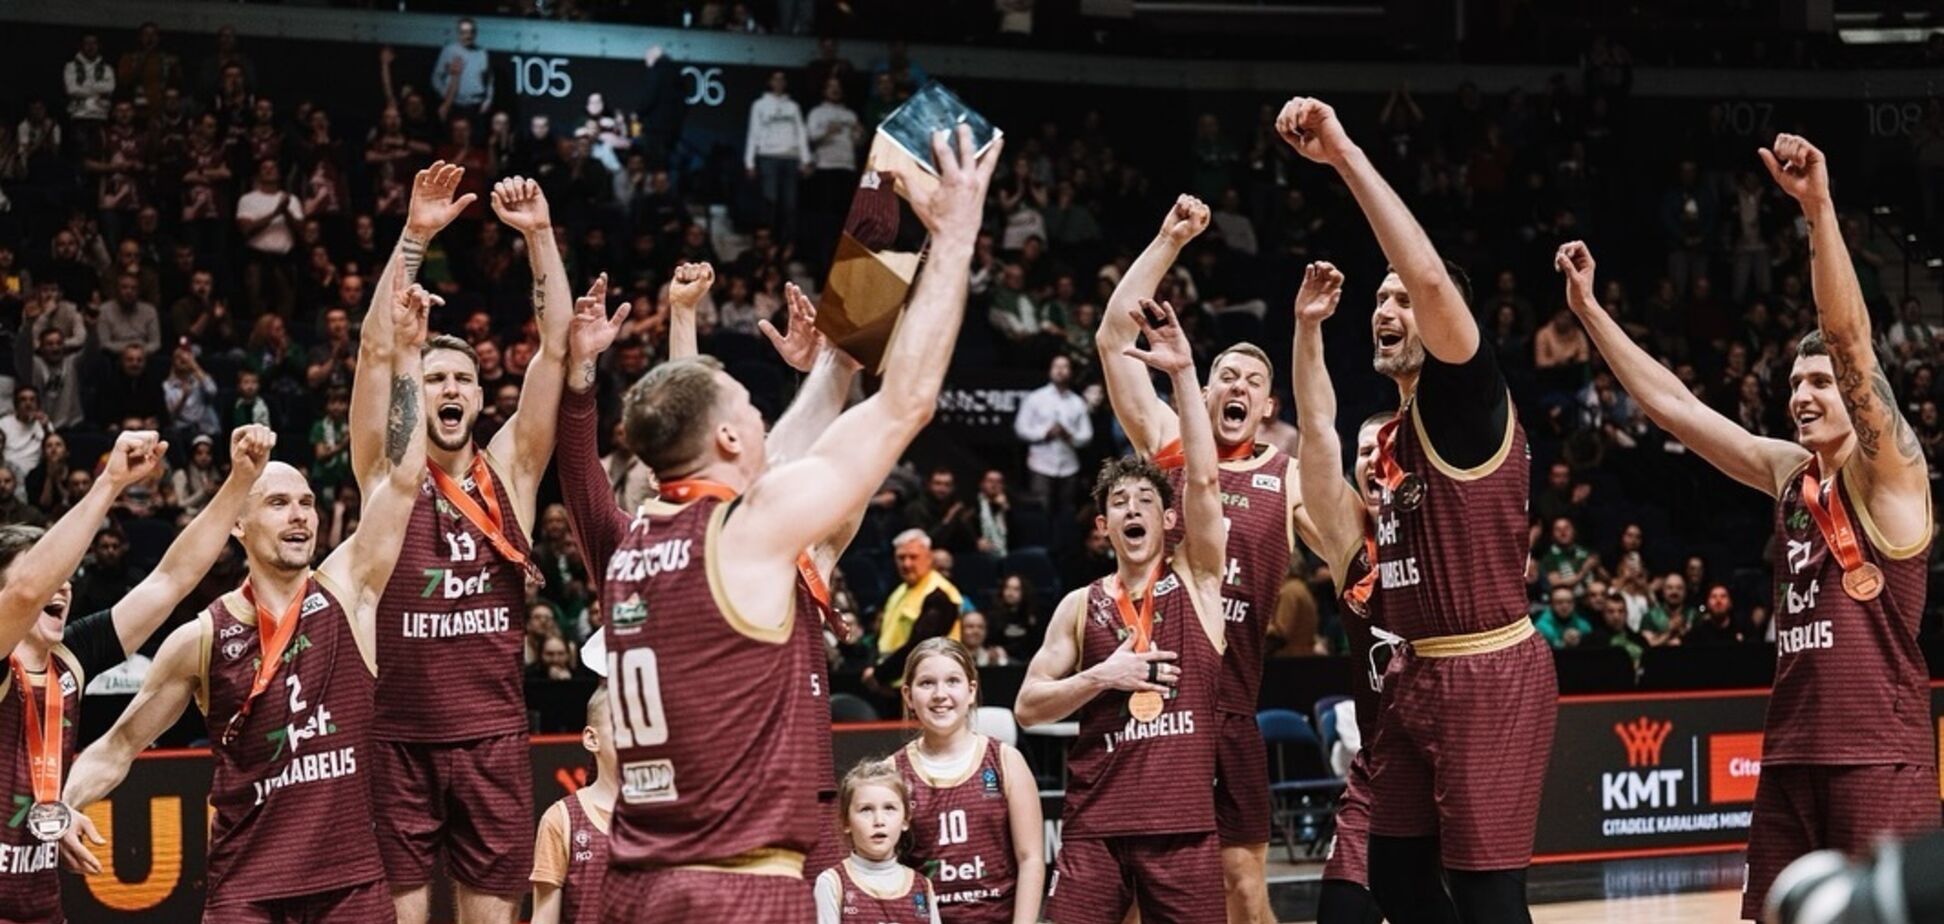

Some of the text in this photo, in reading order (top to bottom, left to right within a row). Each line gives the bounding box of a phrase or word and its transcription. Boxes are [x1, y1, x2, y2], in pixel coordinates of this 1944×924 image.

[512, 56, 572, 97] 105
[681, 66, 725, 106] 06
[446, 532, 477, 562] 13
[403, 607, 510, 638] LIETKABELIS
[286, 674, 307, 713] 2
[607, 647, 669, 749] 10
[1602, 769, 1684, 811] KMT
[938, 809, 968, 846] 10
